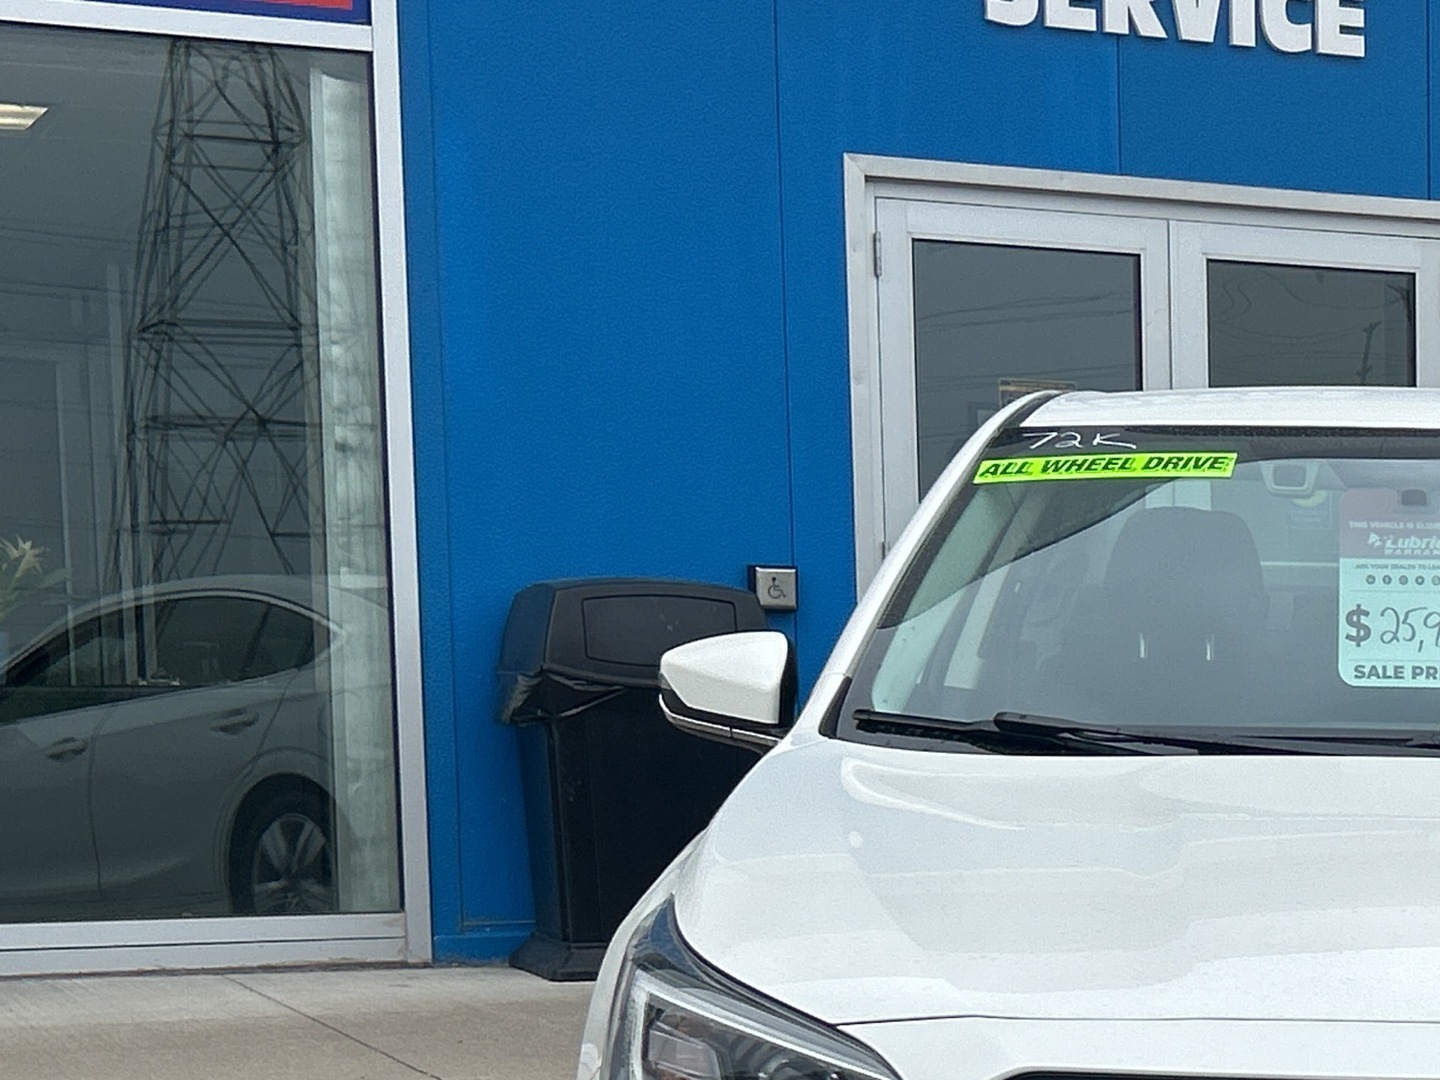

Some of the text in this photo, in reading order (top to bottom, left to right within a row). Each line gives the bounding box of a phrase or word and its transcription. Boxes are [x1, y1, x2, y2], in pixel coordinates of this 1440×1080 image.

[980, 456, 1233, 478] ALL WHEEL DRIVE
[1345, 604, 1371, 647] $
[1354, 665, 1405, 679] SALE
